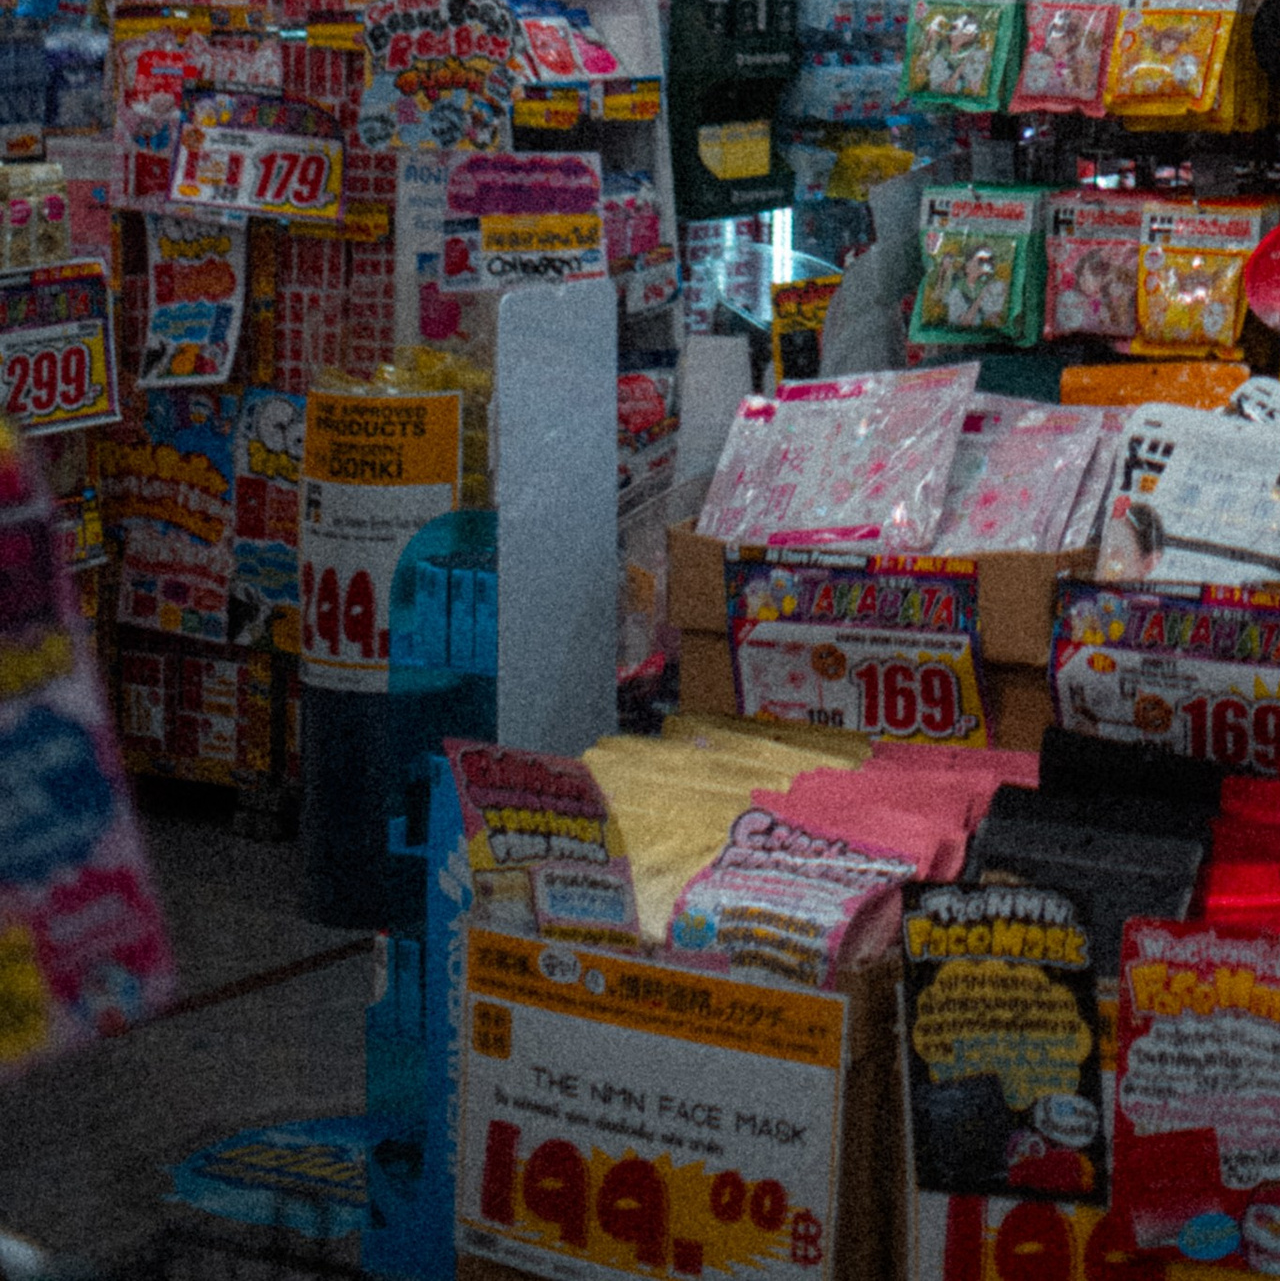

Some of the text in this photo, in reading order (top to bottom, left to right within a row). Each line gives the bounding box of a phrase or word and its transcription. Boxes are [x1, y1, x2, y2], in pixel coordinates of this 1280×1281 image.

[254, 150, 330, 204] 179
[5, 344, 88, 415] 299
[315, 416, 427, 438] PRODUCTS
[304, 561, 389, 660] 99.
[854, 659, 957, 734] 169
[982, 893, 1070, 925] NMN
[905, 917, 1089, 966] Face Mask
[1130, 961, 1212, 1016] Face
[532, 1066, 578, 1098] THE
[590, 1084, 647, 1115] NMN
[658, 1094, 723, 1131] FACE
[734, 1110, 807, 1148] MASK
